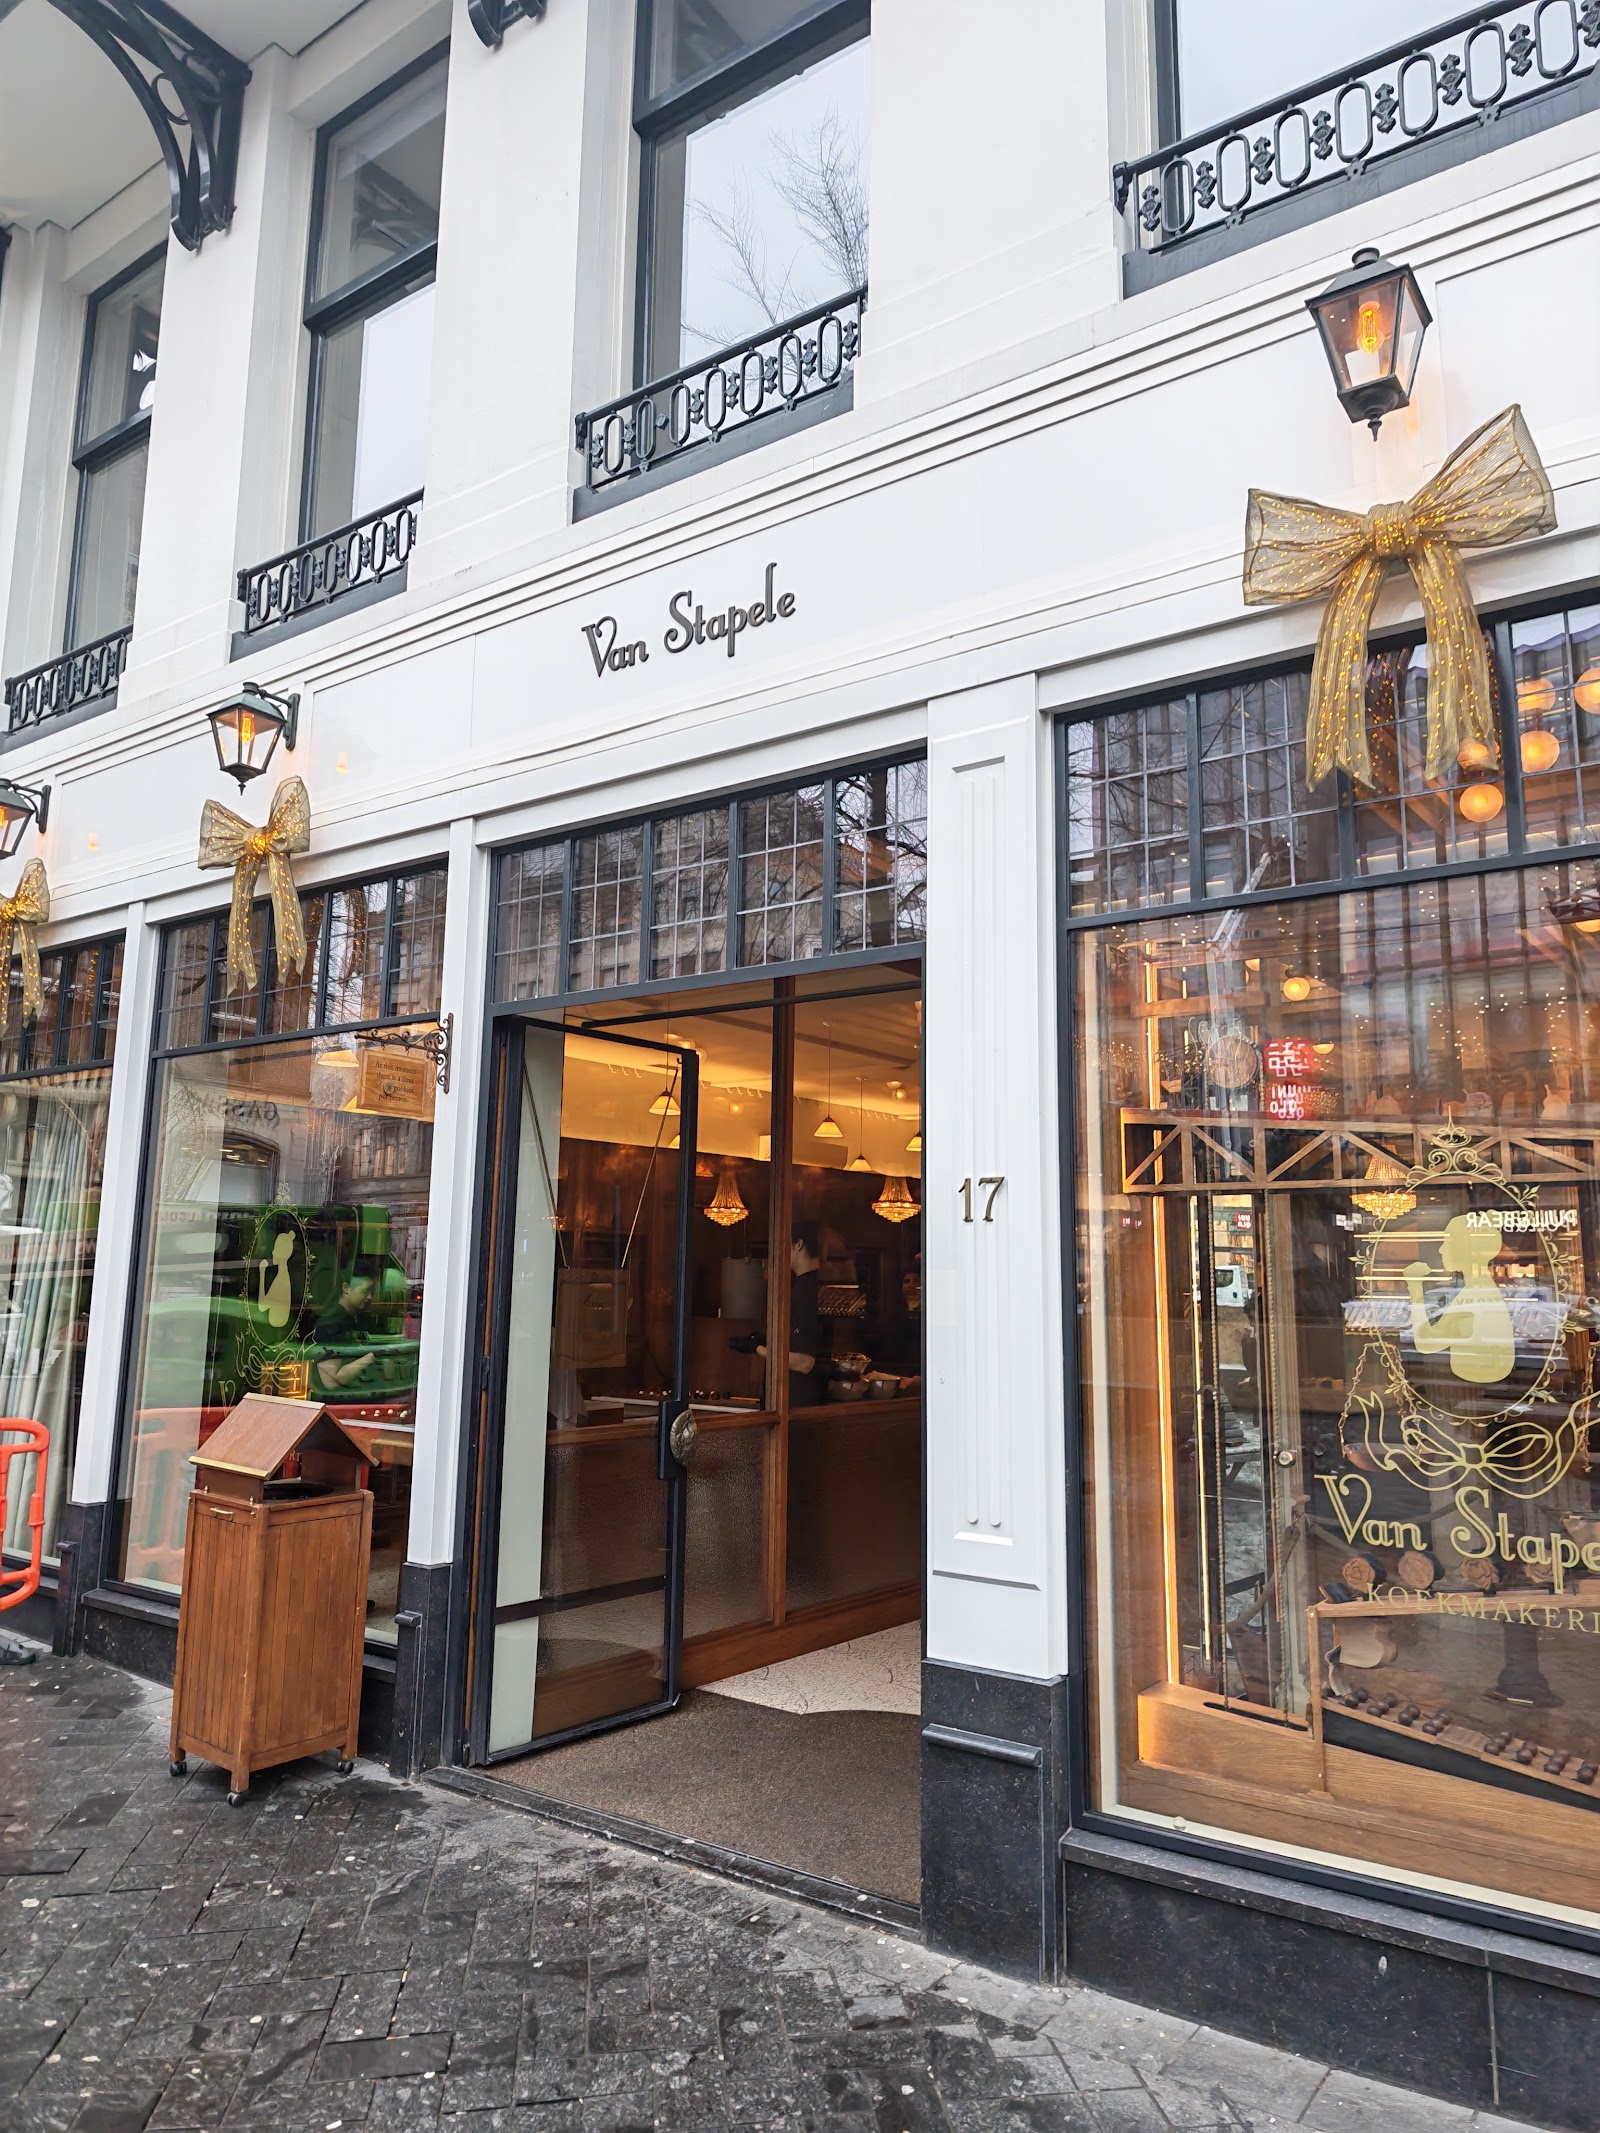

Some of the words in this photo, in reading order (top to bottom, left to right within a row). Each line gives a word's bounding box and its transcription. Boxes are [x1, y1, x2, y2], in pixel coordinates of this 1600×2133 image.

[581, 615, 649, 677] Van
[663, 562, 796, 657] Stapele
[958, 1176, 1005, 1222] 17
[1314, 1474, 1428, 1551] Van
